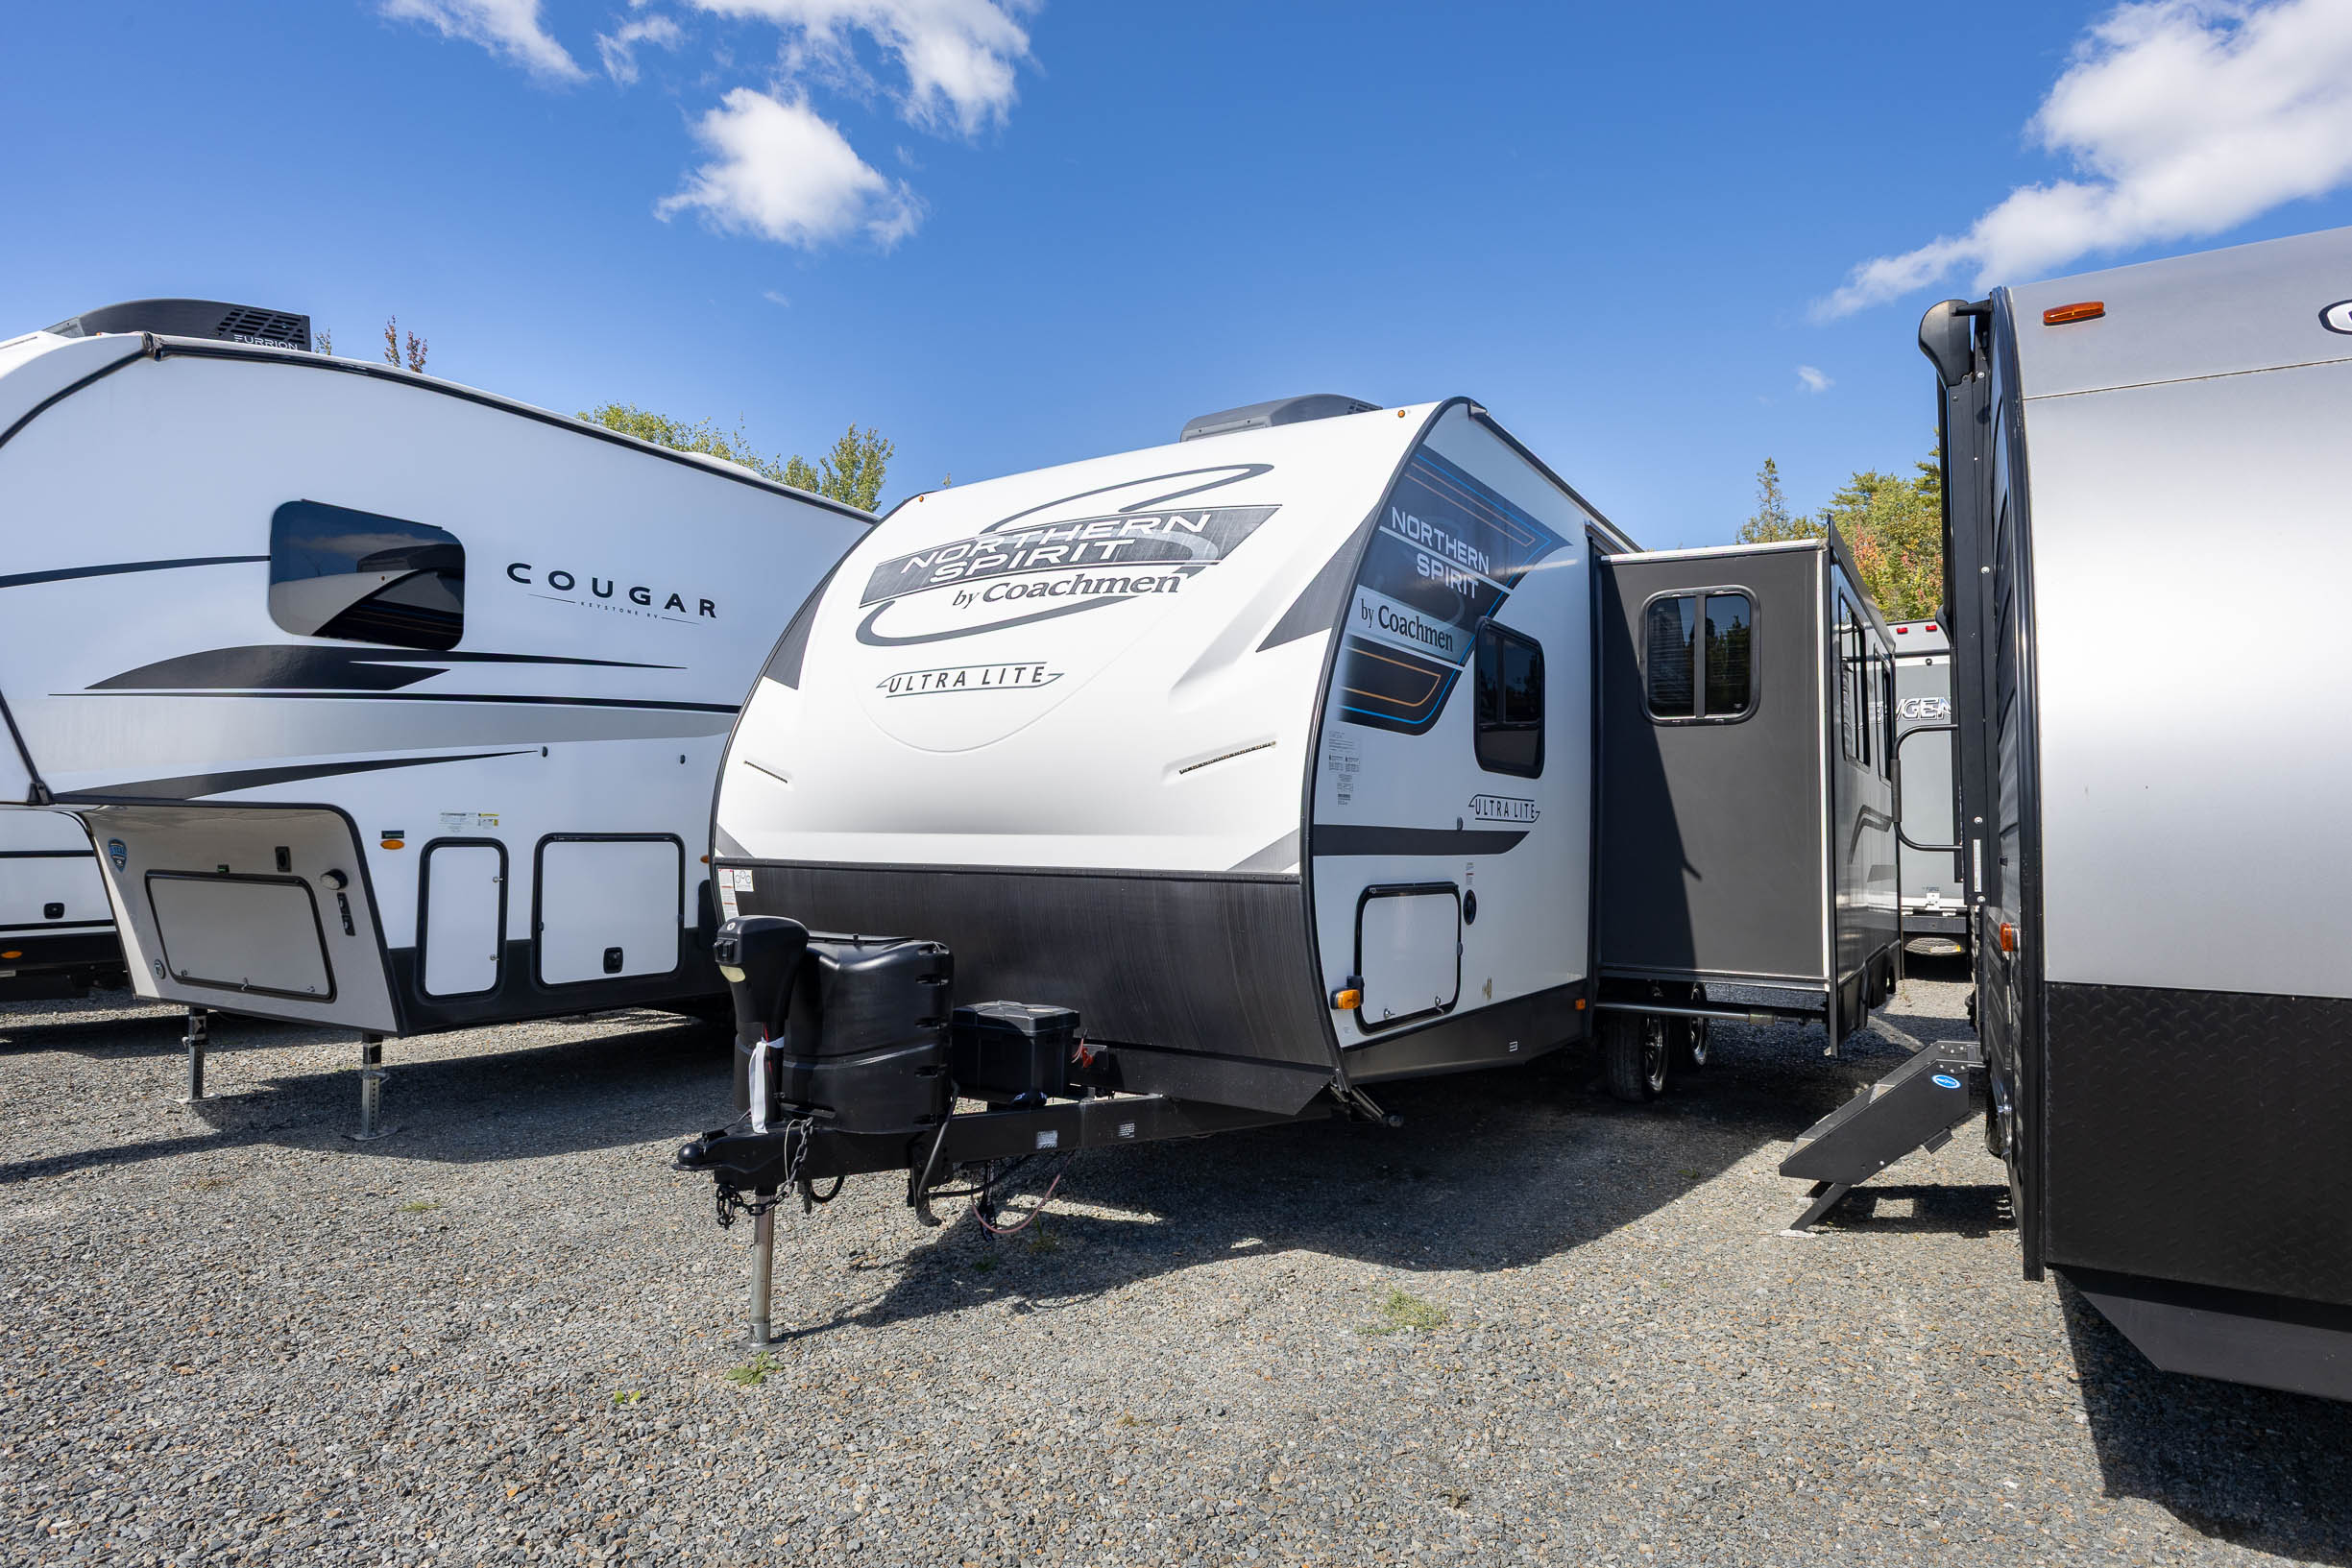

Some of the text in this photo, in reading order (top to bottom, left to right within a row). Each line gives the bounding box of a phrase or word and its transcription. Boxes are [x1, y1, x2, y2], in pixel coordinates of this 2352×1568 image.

[233, 334, 299, 350] FURRION
[901, 514, 1212, 575] NORTHERN
[929, 539, 1138, 584] SPIRIT
[1392, 506, 1490, 575] NORTHERN
[506, 562, 717, 619] COUGAR
[952, 572, 1183, 610] by Coachmen
[1417, 552, 1479, 599] SPIRIT
[580, 601, 639, 615] KEYSTONE
[1361, 598, 1453, 653] by Coachmen
[889, 665, 1045, 693] ULTRA LITE
[1475, 798, 1535, 819] ULTRA LITE
